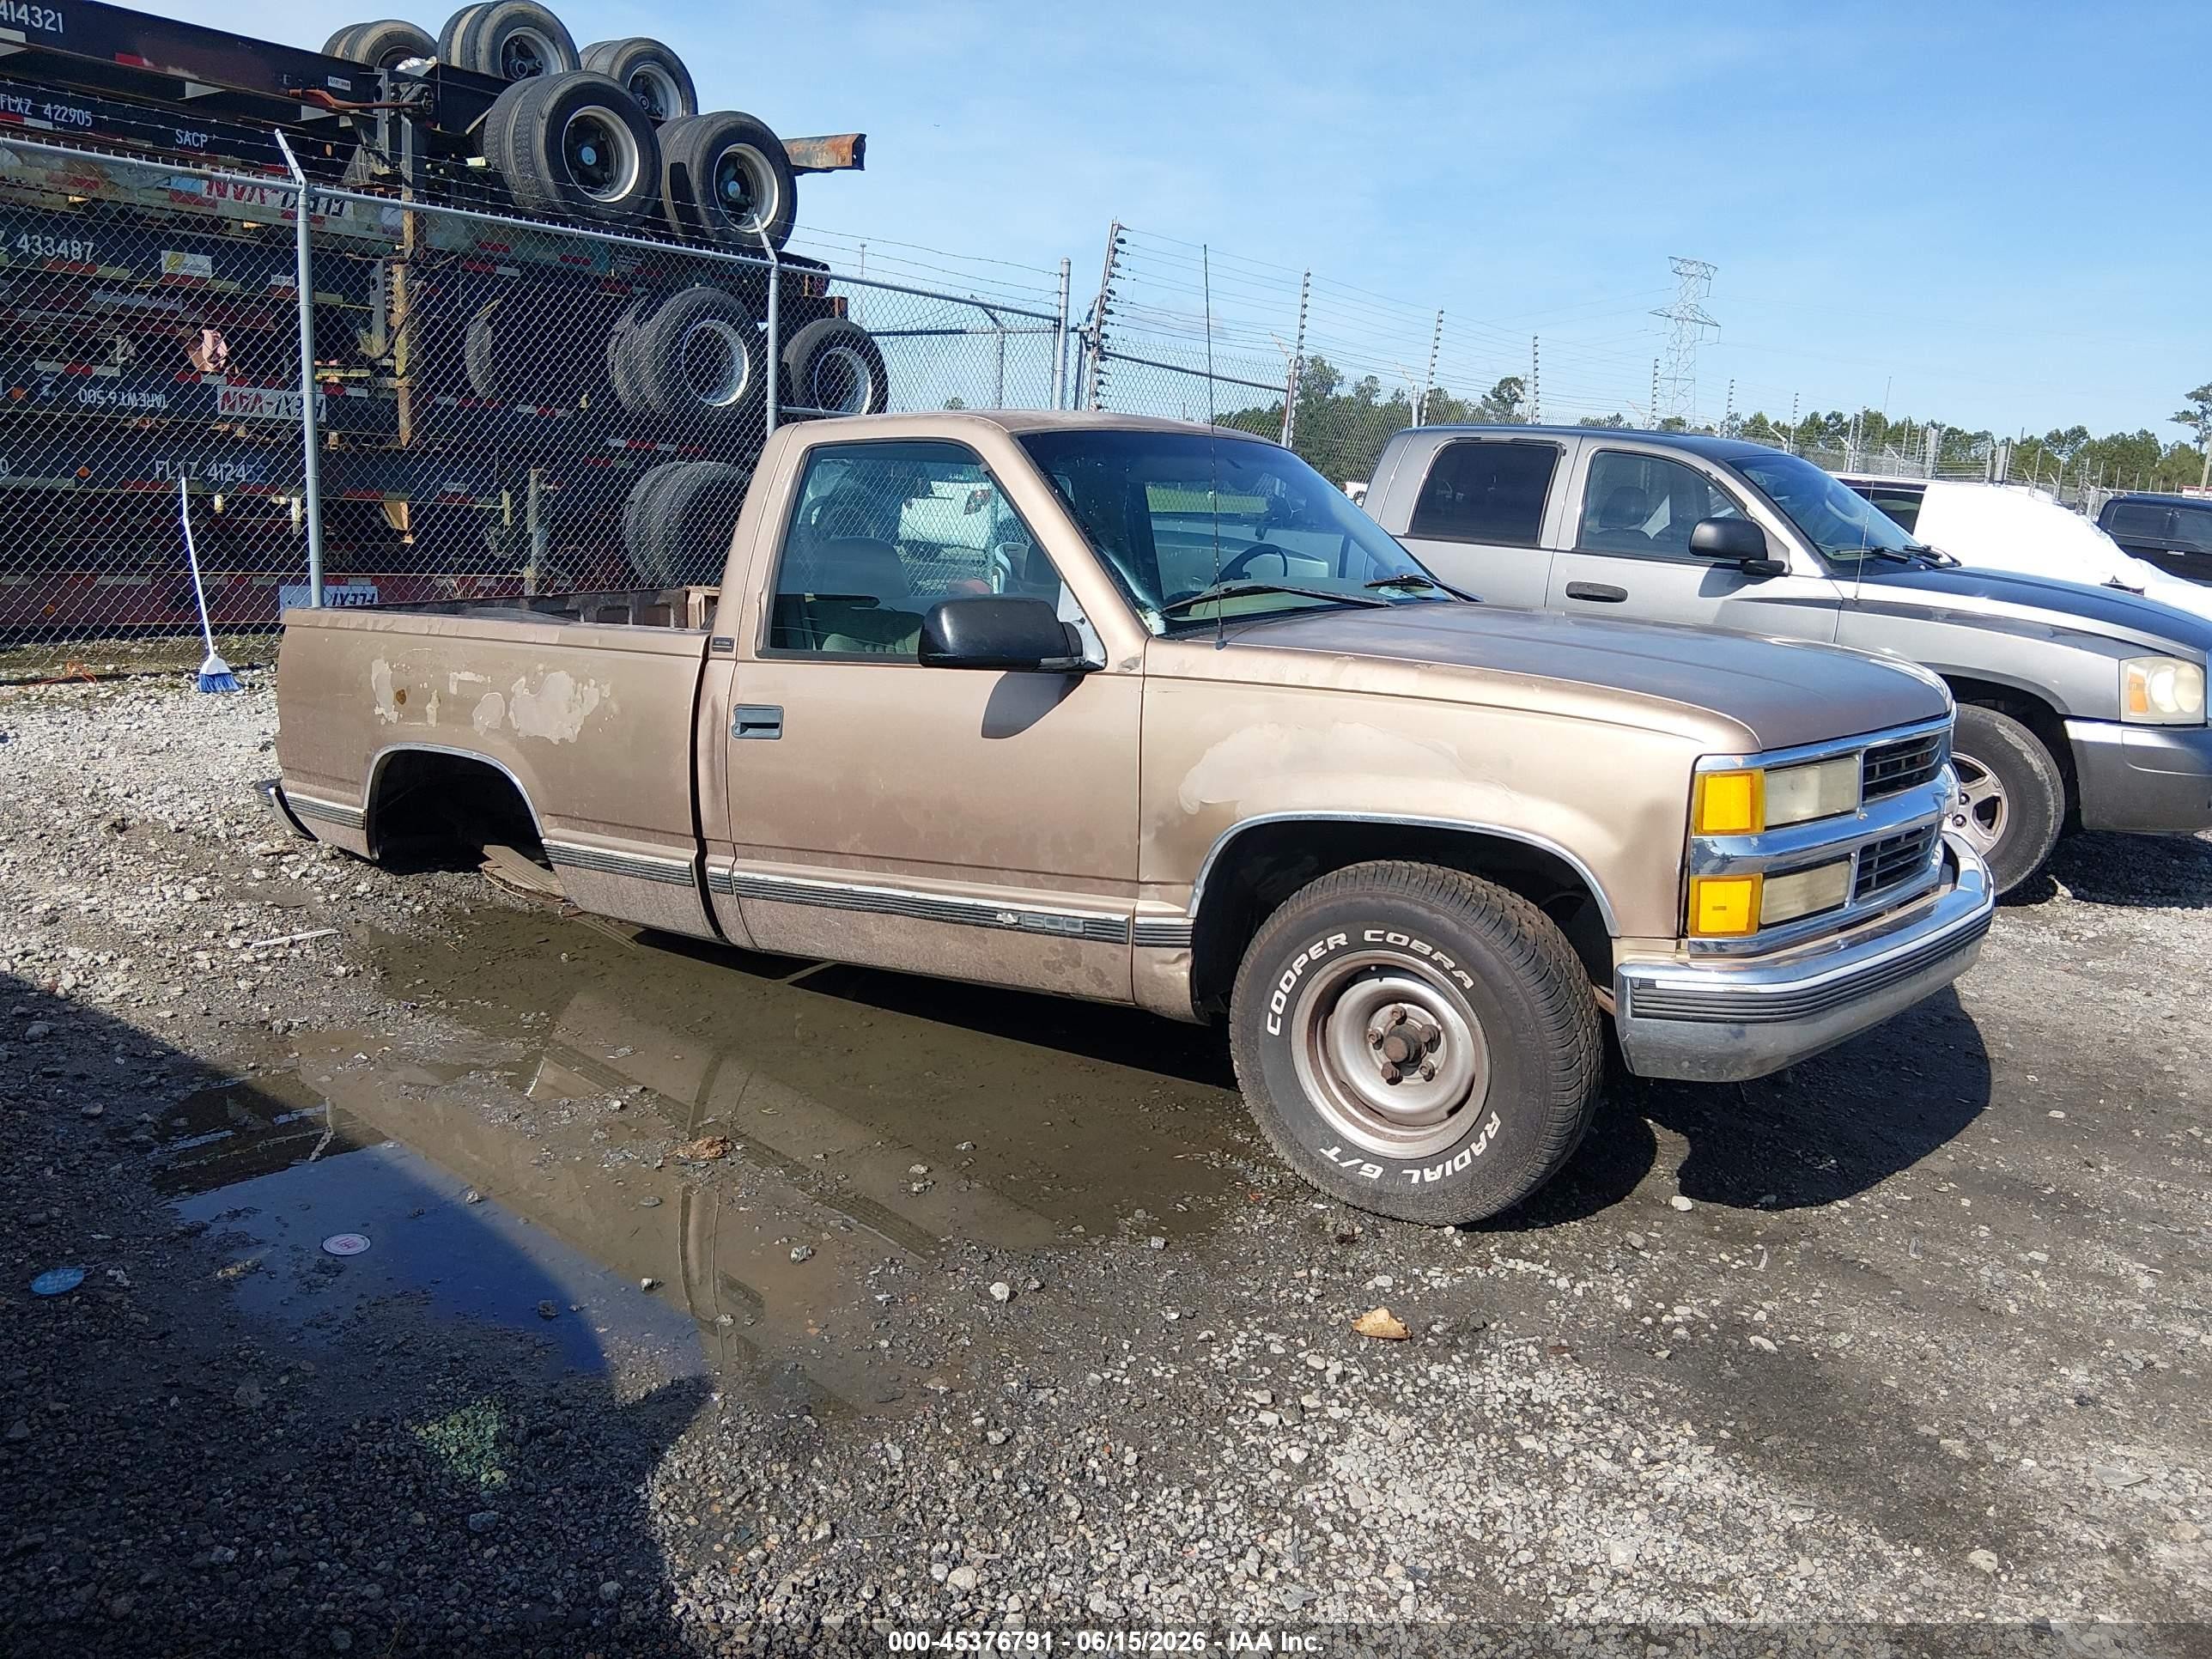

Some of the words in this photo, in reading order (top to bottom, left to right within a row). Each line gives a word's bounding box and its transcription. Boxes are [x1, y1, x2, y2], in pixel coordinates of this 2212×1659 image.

[0, 0, 64, 33] 414321
[1, 93, 33, 116] FLXZ
[44, 102, 93, 127] 422905
[174, 129, 208, 149] SACP
[16, 233, 94, 260] 433487
[1267, 933, 1348, 1036] COOPER
[1364, 929, 1474, 989] COBRA
[1319, 1146, 1384, 1179] G/T
[1401, 1110, 1501, 1184] RADIAL
